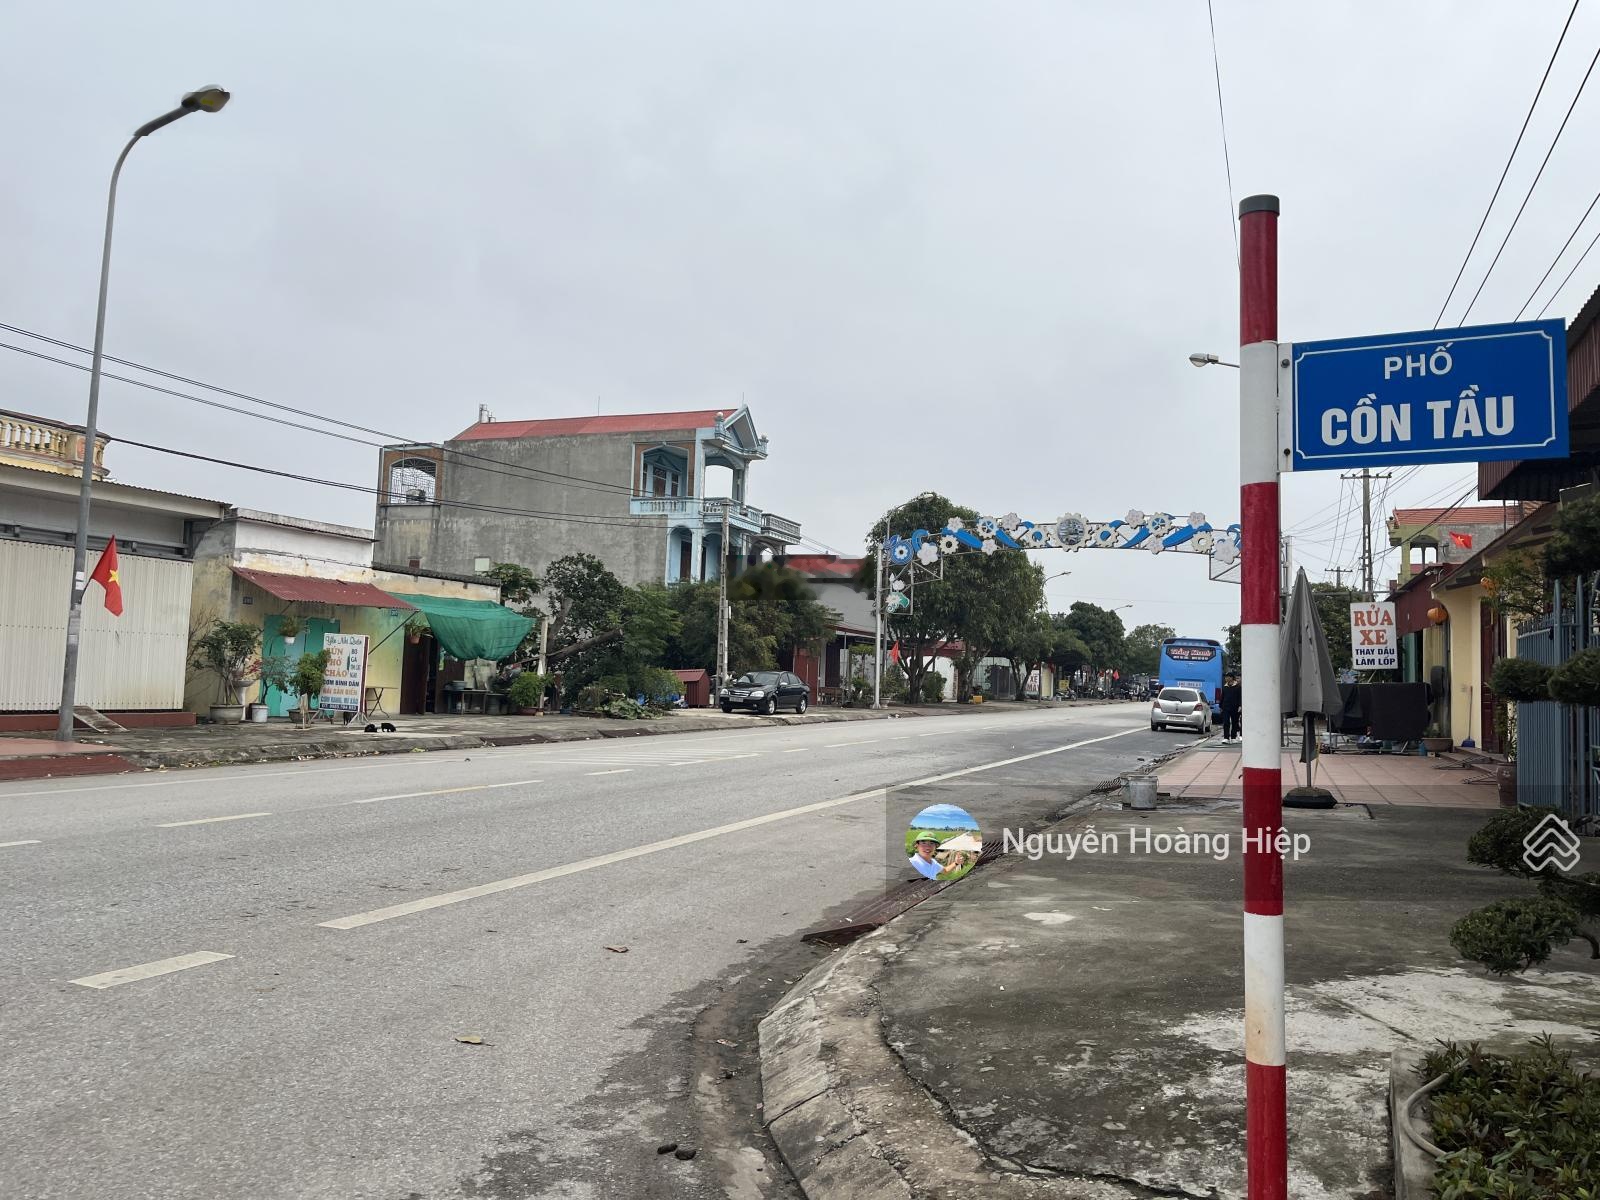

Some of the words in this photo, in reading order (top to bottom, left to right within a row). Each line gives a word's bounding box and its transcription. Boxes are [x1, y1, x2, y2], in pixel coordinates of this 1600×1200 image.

[1384, 342, 1453, 380] PHỐ
[1321, 393, 1411, 446] CỒN
[1426, 384, 1515, 440] TẦU
[1353, 604, 1394, 627] RỬA
[1359, 629, 1388, 646] XE
[1378, 655, 1396, 666] LỐP
